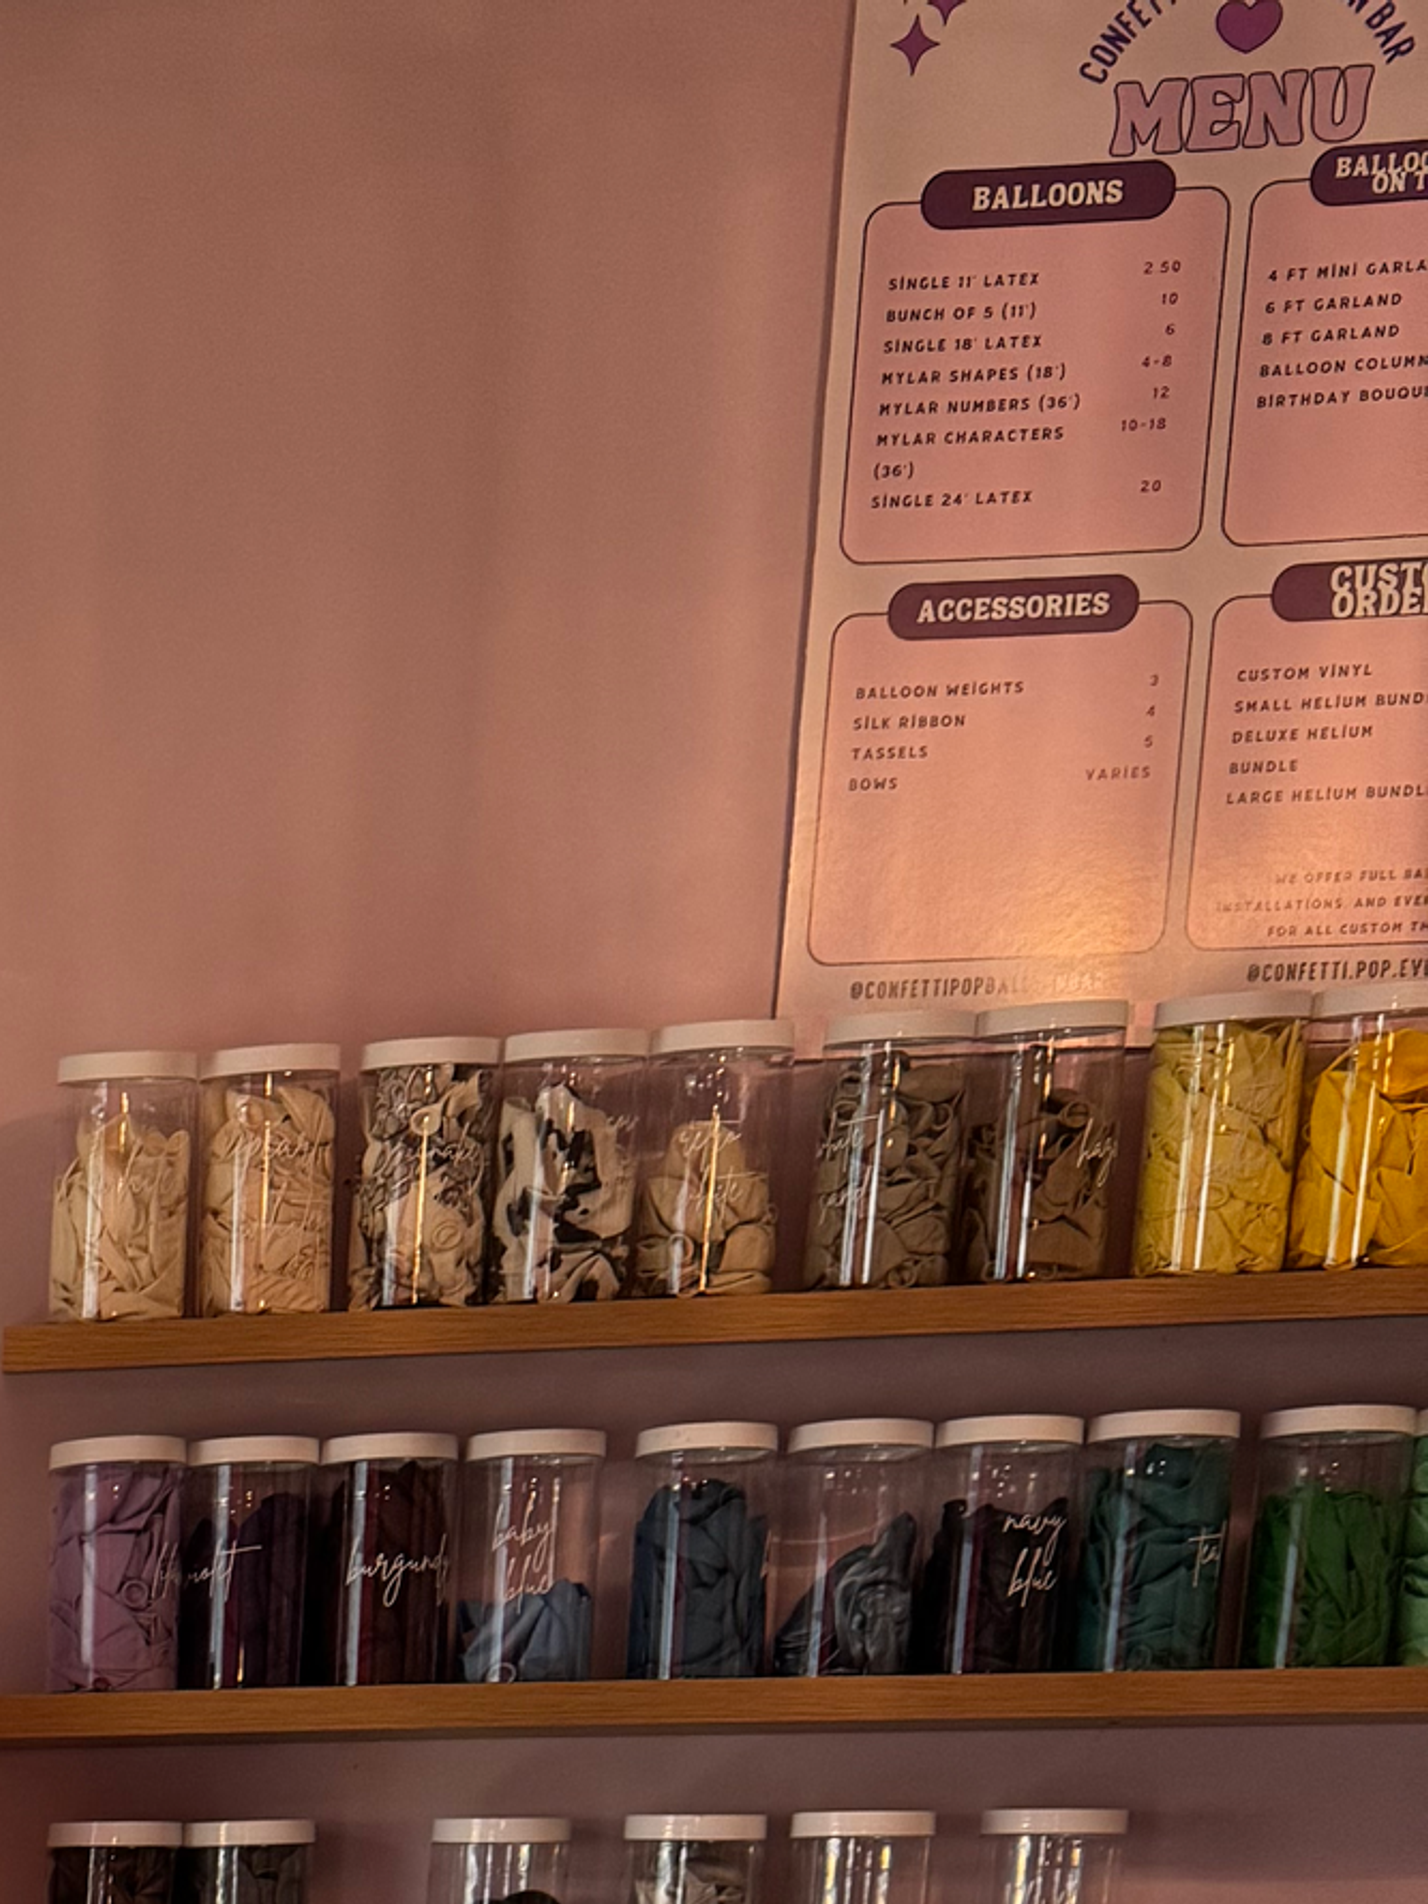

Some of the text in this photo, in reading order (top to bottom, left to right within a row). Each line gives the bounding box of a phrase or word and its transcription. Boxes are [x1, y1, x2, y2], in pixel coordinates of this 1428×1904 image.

[1365, 0, 1415, 65] BAR
[1109, 64, 1375, 157] MENU
[972, 179, 1124, 211] BALLOONS
[888, 275, 951, 291] SINGLE
[983, 272, 1039, 288] LATEX
[1268, 270, 1277, 282] 4
[1286, 268, 1308, 281] FT
[1317, 262, 1358, 278] MINI
[1161, 292, 1179, 305] 10
[1265, 293, 1402, 314] 6 FT GARLAND
[886, 307, 945, 323] BUNCH
[953, 306, 976, 320] OF
[983, 306, 994, 319] 5
[1165, 323, 1175, 336] 6
[1262, 325, 1400, 345] 8 FT GARLAND
[883, 337, 946, 354] SINGLE
[984, 335, 1042, 350] LATEX
[881, 369, 942, 385] MYLAR
[949, 367, 1019, 383] SHAPES
[1259, 360, 1346, 378] BALLOON
[1152, 386, 1170, 399] 12
[1256, 390, 1350, 409] BIRTHDAY
[879, 401, 939, 417] MYLAR
[947, 398, 1031, 413] NUMBERS
[876, 427, 1064, 447] MYLAR CHARACTERS
[1140, 480, 1162, 493] 20
[871, 492, 934, 510] SINGLE
[975, 491, 1033, 505] LATEX
[916, 592, 1110, 623] ACCESSORIES
[1237, 663, 1372, 682] CUSTOM VINYL
[855, 680, 1025, 700] BALLOON WEIGHTS
[1234, 691, 1428, 714] SMALL HELIUM BUND
[852, 714, 966, 731] SILK RIBBON
[1231, 724, 1373, 744] DELUXE HELIUM
[851, 745, 929, 761] TASSELS
[1085, 766, 1151, 781] VARIES
[1228, 759, 1298, 775] BUNDLE
[848, 777, 898, 792] BOWS
[1226, 790, 1283, 805] LARGE
[1291, 786, 1357, 802] HELIUM
[1359, 869, 1397, 881] FULL
[1353, 896, 1387, 909] AND
[1267, 925, 1298, 937] FOR
[1304, 924, 1333, 936] ALL
[1340, 921, 1403, 936] CUSTOM
[1002, 1513, 1067, 1567] navy
[1007, 1547, 1058, 1608] blue
